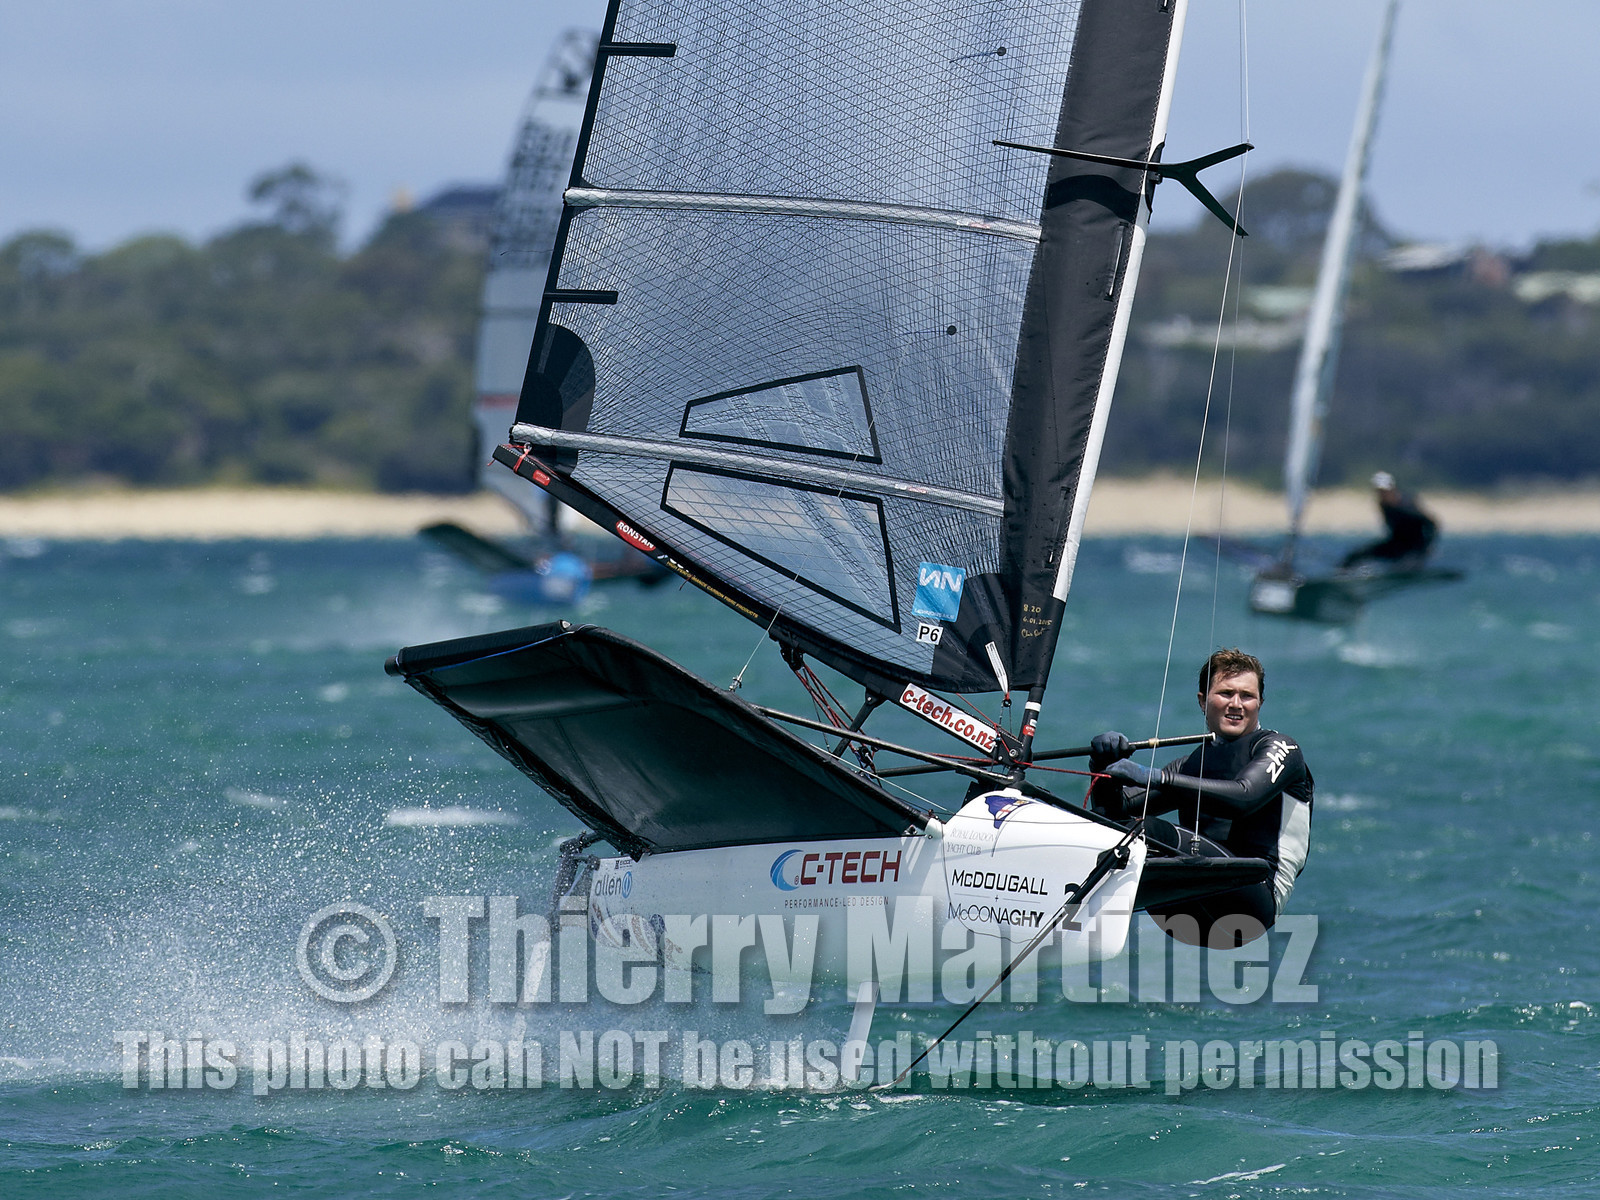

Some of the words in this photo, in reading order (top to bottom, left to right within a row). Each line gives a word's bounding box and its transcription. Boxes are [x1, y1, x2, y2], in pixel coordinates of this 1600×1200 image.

[616, 520, 655, 549] RONSTAN
[919, 625, 940, 642] P6
[902, 689, 996, 750] c-tech.co.nz
[1265, 740, 1297, 784] zhik
[800, 850, 902, 886] C-TECH
[594, 874, 622, 897] allen
[952, 869, 1048, 896] McDOUGALL
[784, 896, 857, 909] PERFORMANCE-LED
[860, 895, 889, 907] DESIGN
[947, 901, 1045, 928] McCONAGHY
